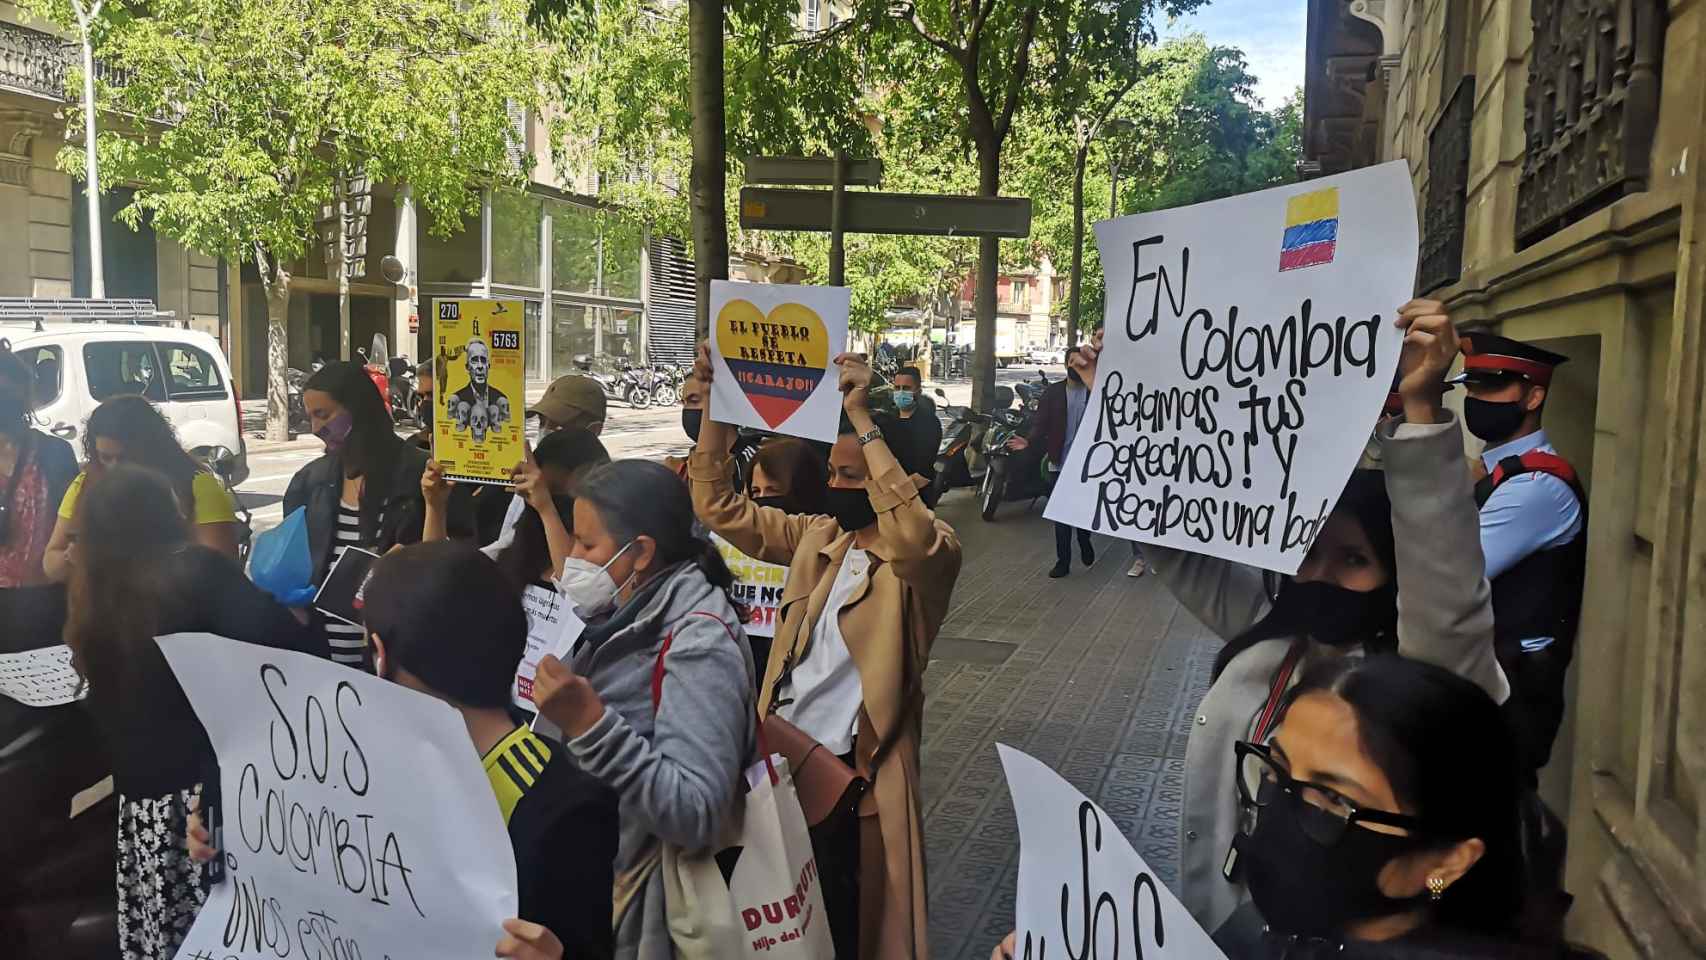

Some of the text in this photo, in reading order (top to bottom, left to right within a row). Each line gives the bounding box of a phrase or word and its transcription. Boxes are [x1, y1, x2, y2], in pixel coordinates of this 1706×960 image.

[441, 303, 458, 319] 270
[494, 333, 517, 348] 5763
[729, 320, 811, 342] EL PUEBLO
[762, 335, 779, 350] SE
[740, 346, 808, 368] RESPETA
[1239, 378, 1307, 447] tus
[1222, 499, 1275, 547] una
[752, 927, 801, 952] Hijo del
